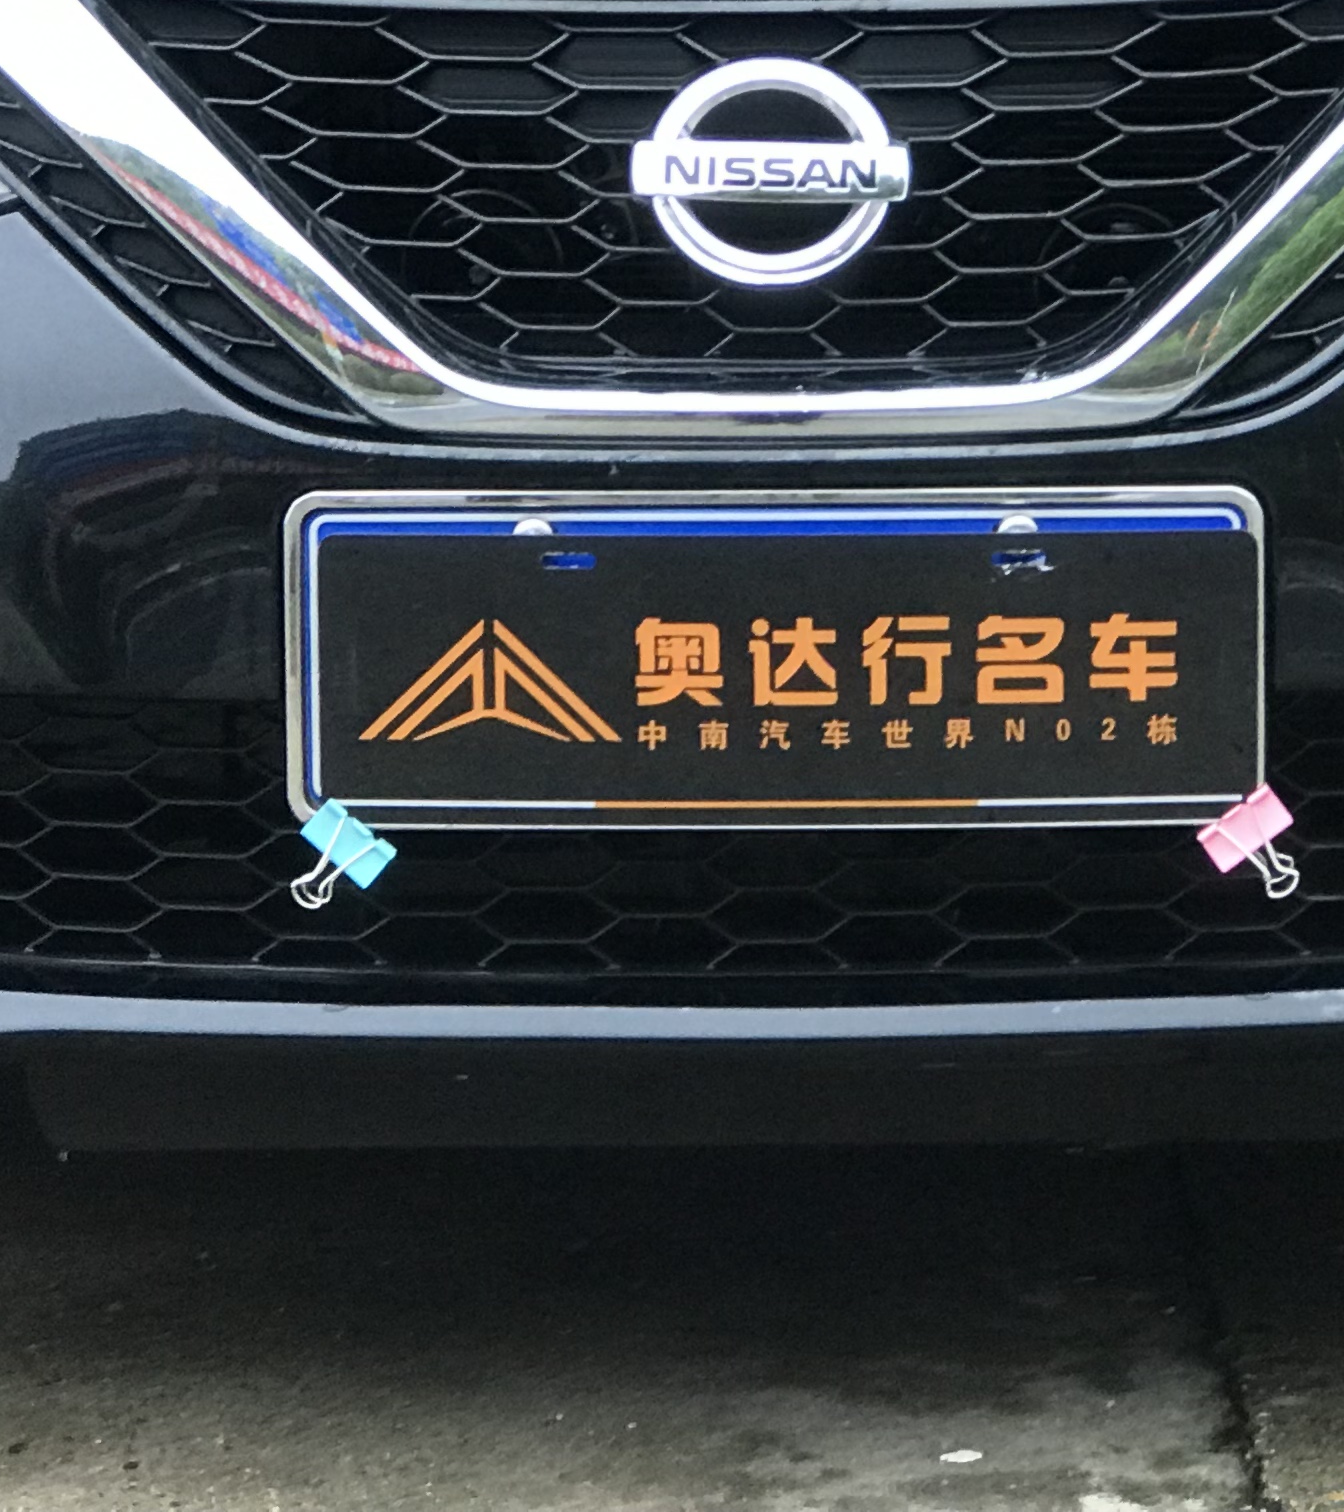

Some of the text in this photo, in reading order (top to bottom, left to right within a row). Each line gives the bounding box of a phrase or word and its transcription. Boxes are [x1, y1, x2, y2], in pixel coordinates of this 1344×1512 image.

[664, 155, 877, 188] NISSAN
[634, 613, 1179, 707] 奥达行名车
